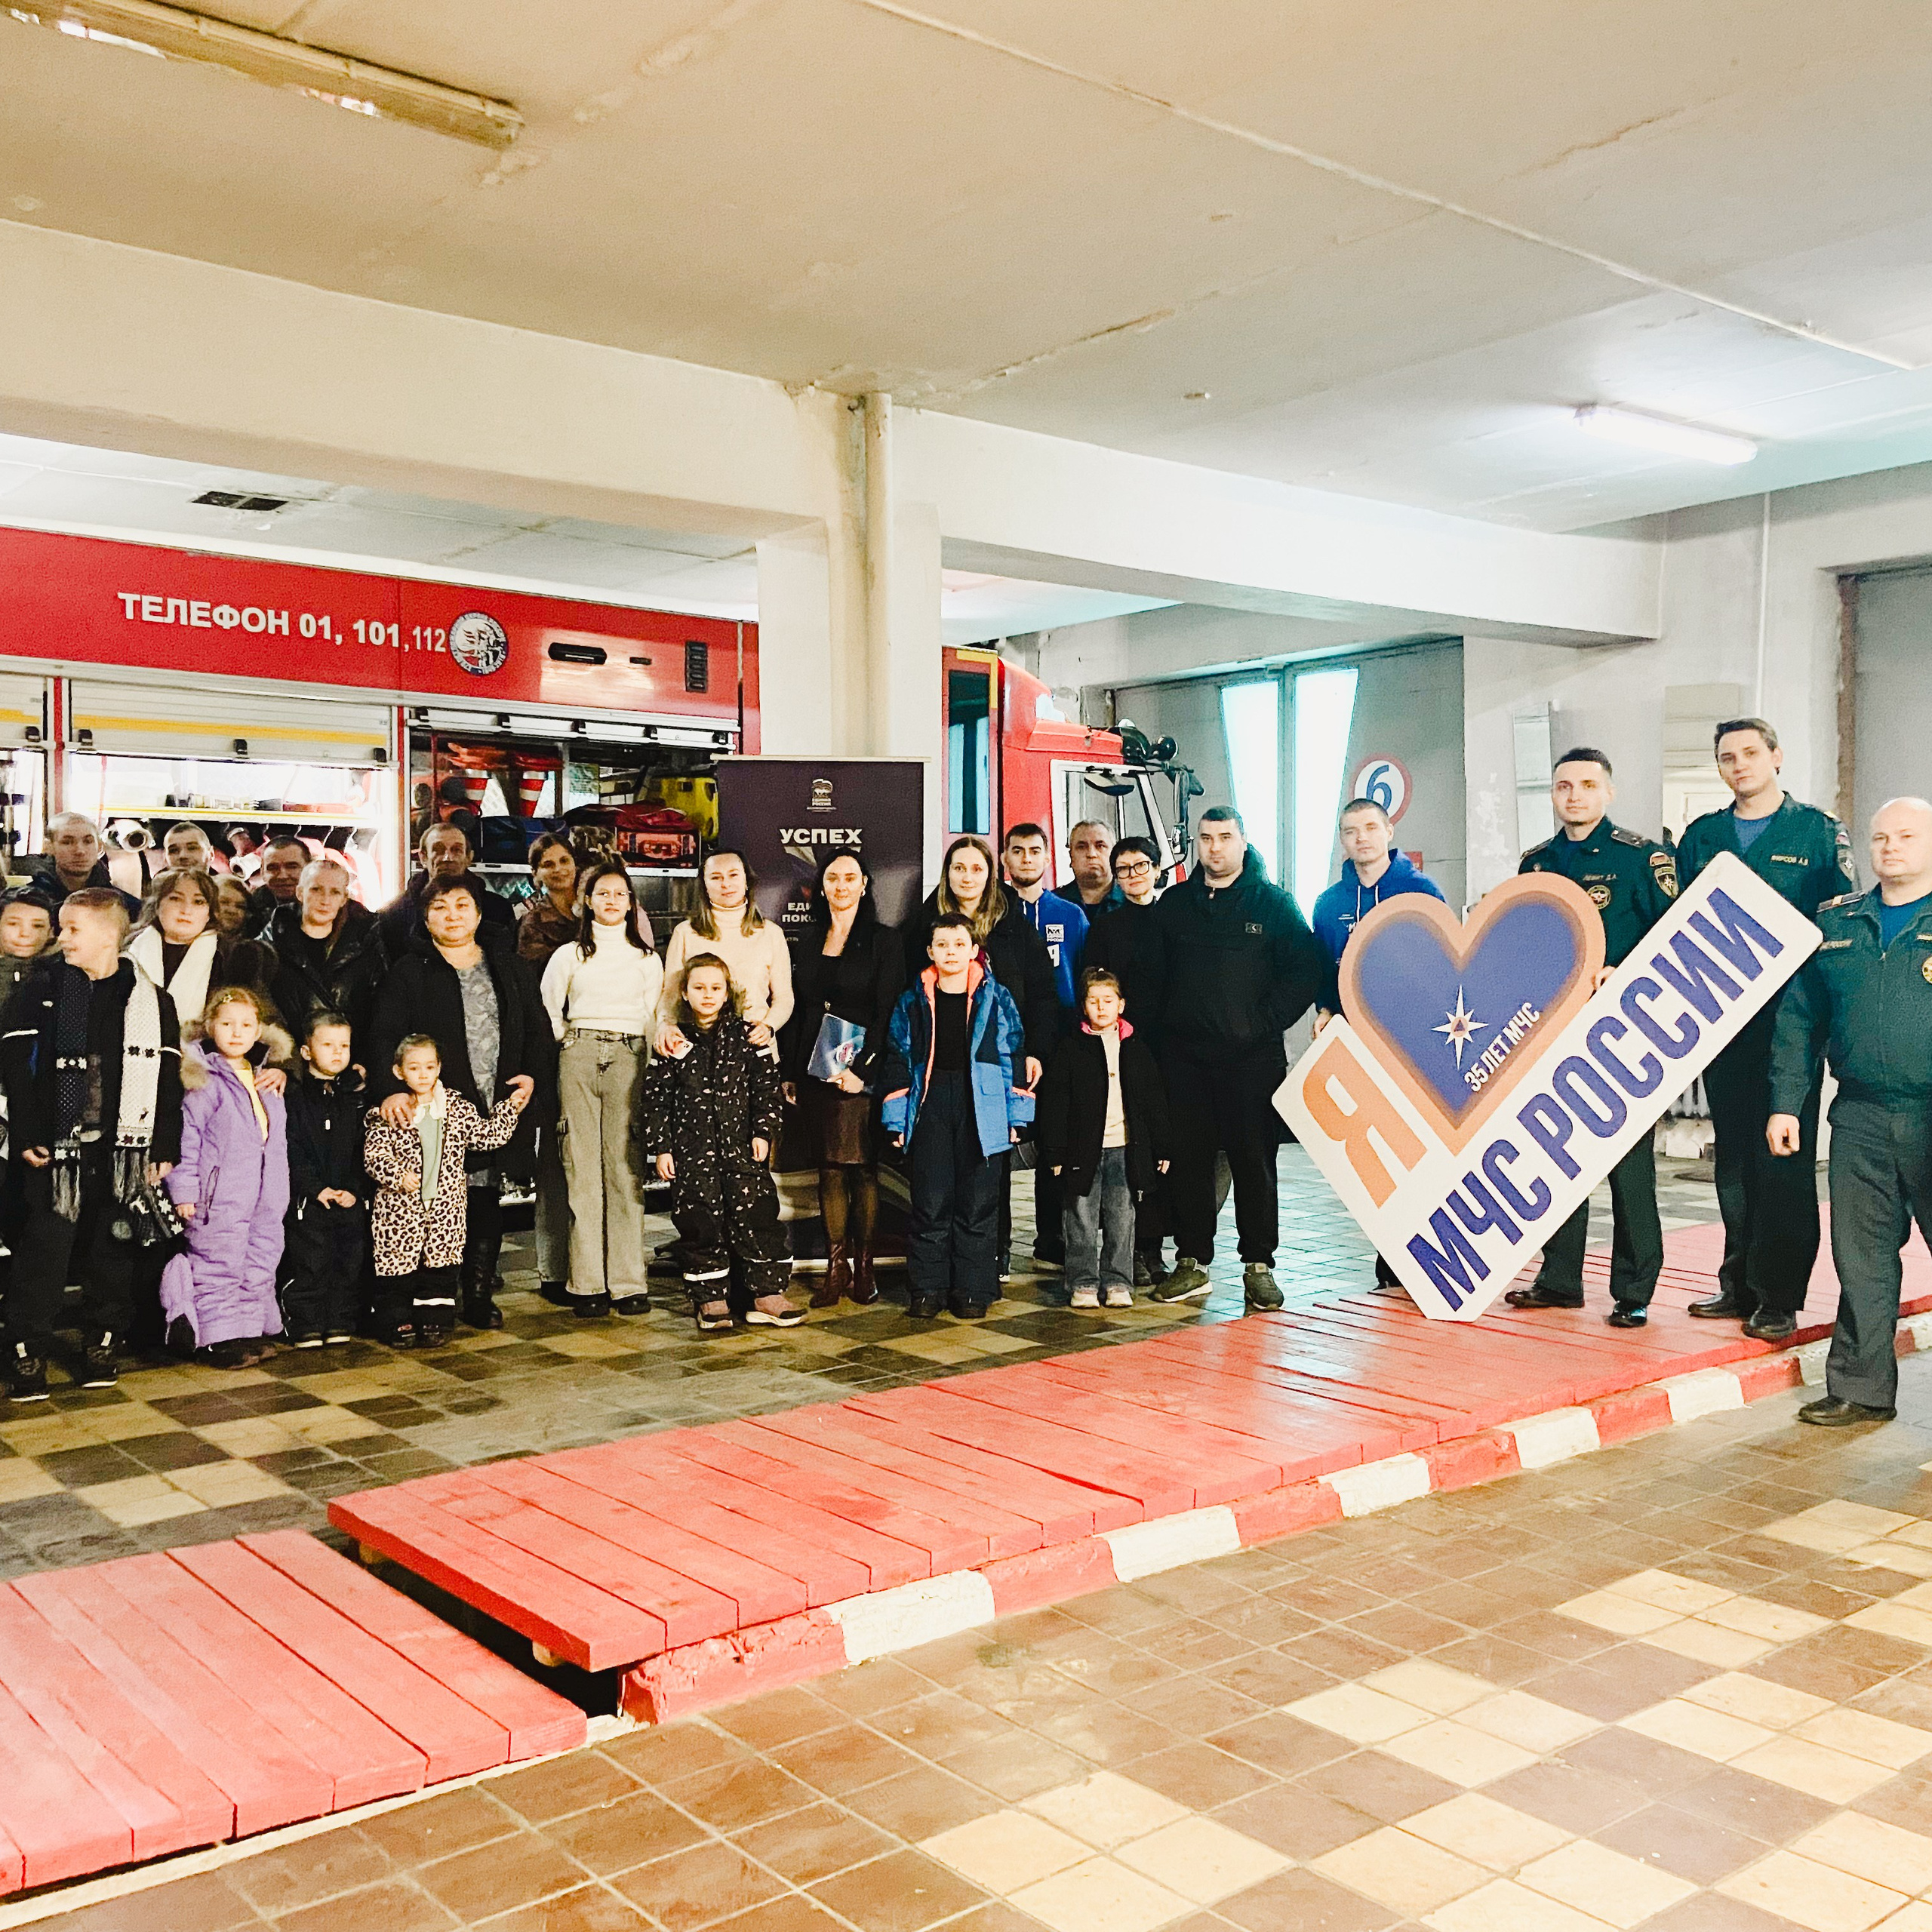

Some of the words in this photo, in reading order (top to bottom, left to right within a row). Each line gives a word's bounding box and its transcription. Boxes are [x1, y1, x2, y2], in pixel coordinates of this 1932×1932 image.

[118, 592, 290, 636] ТЕЛЕФОН
[299, 613, 343, 645] 01,
[1366, 764, 1392, 811] 6
[779, 828, 863, 844] УСПЕХ
[1464, 1062, 1489, 1092] 35
[1480, 1034, 1512, 1074] ЛЕТ
[1502, 1001, 1540, 1046] МЧС
[1303, 1035, 1427, 1209] Я
[1406, 1139, 1552, 1312] МЧС
[1516, 887, 1784, 1180] РОССИИ
